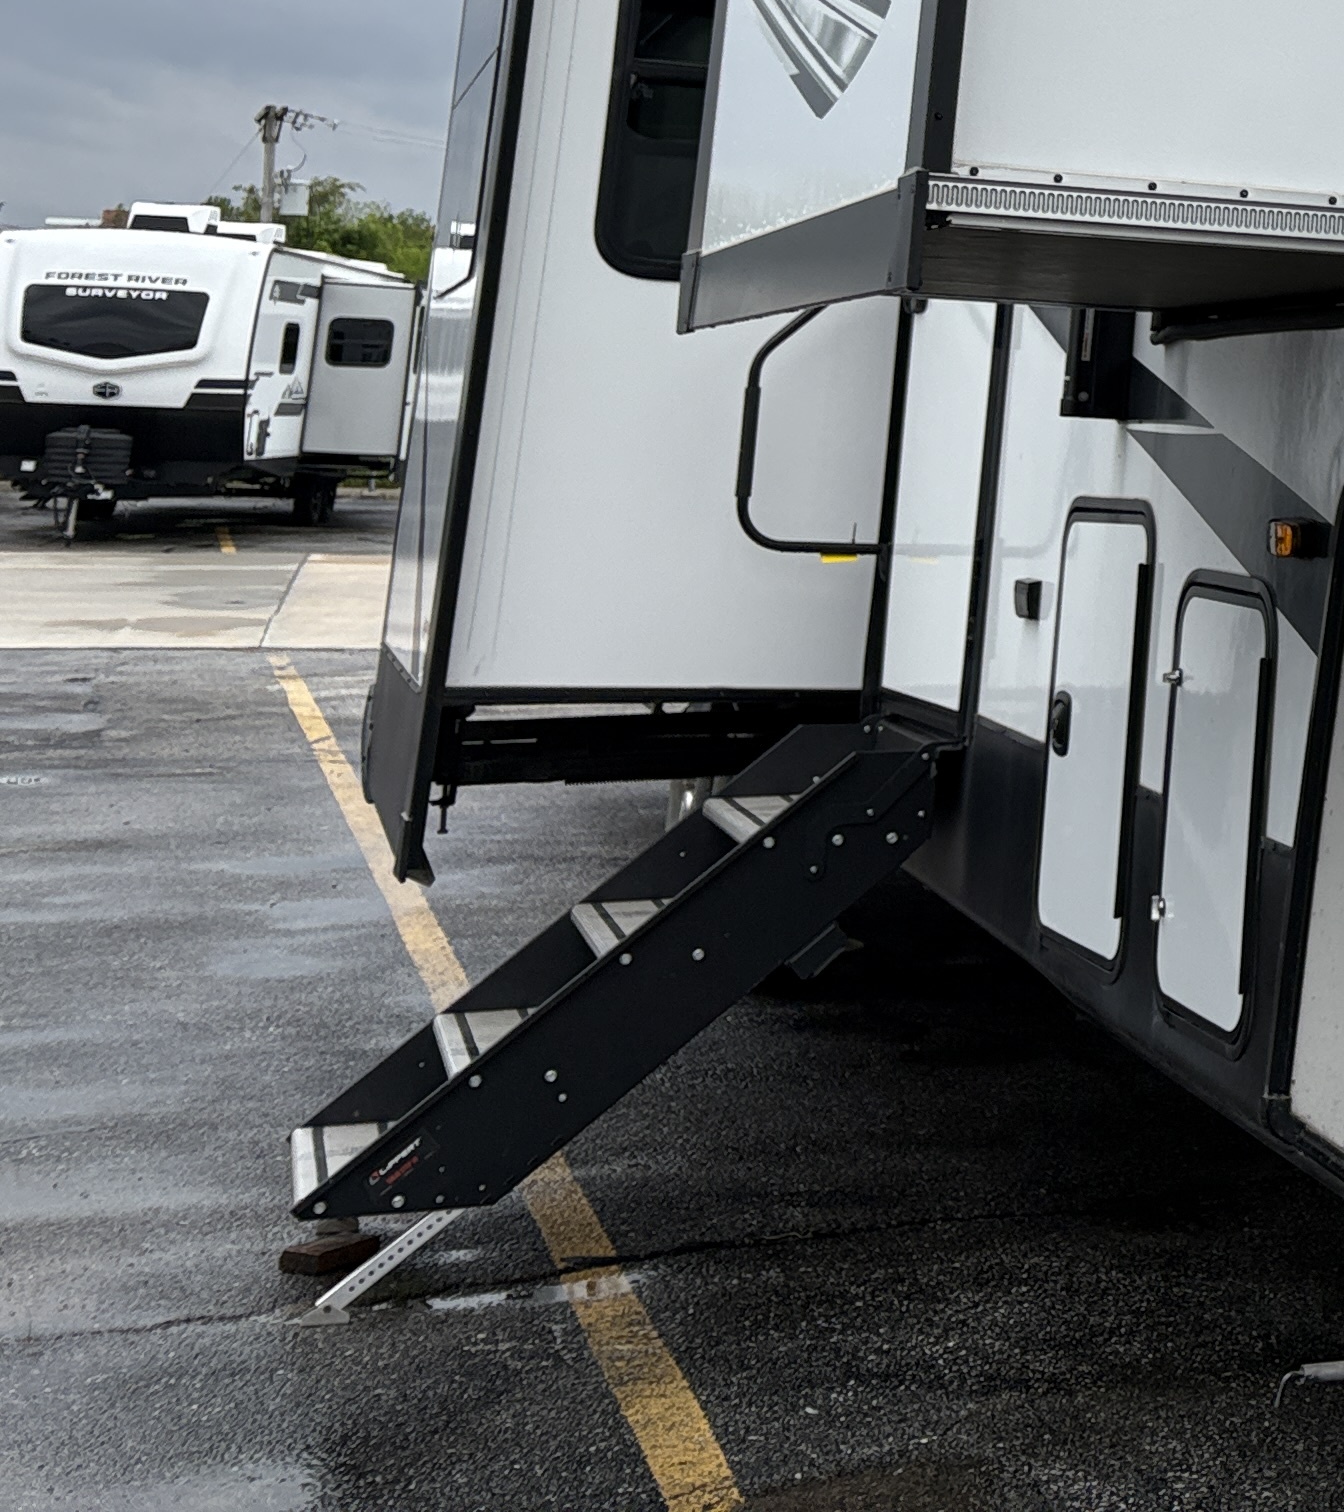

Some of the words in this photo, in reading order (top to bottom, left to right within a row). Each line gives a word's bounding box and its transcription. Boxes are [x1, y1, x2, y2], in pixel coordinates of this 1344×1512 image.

[44, 270, 123, 283] FOREST
[127, 274, 188, 286] RIVER
[65, 287, 169, 300] SURVEYOR
